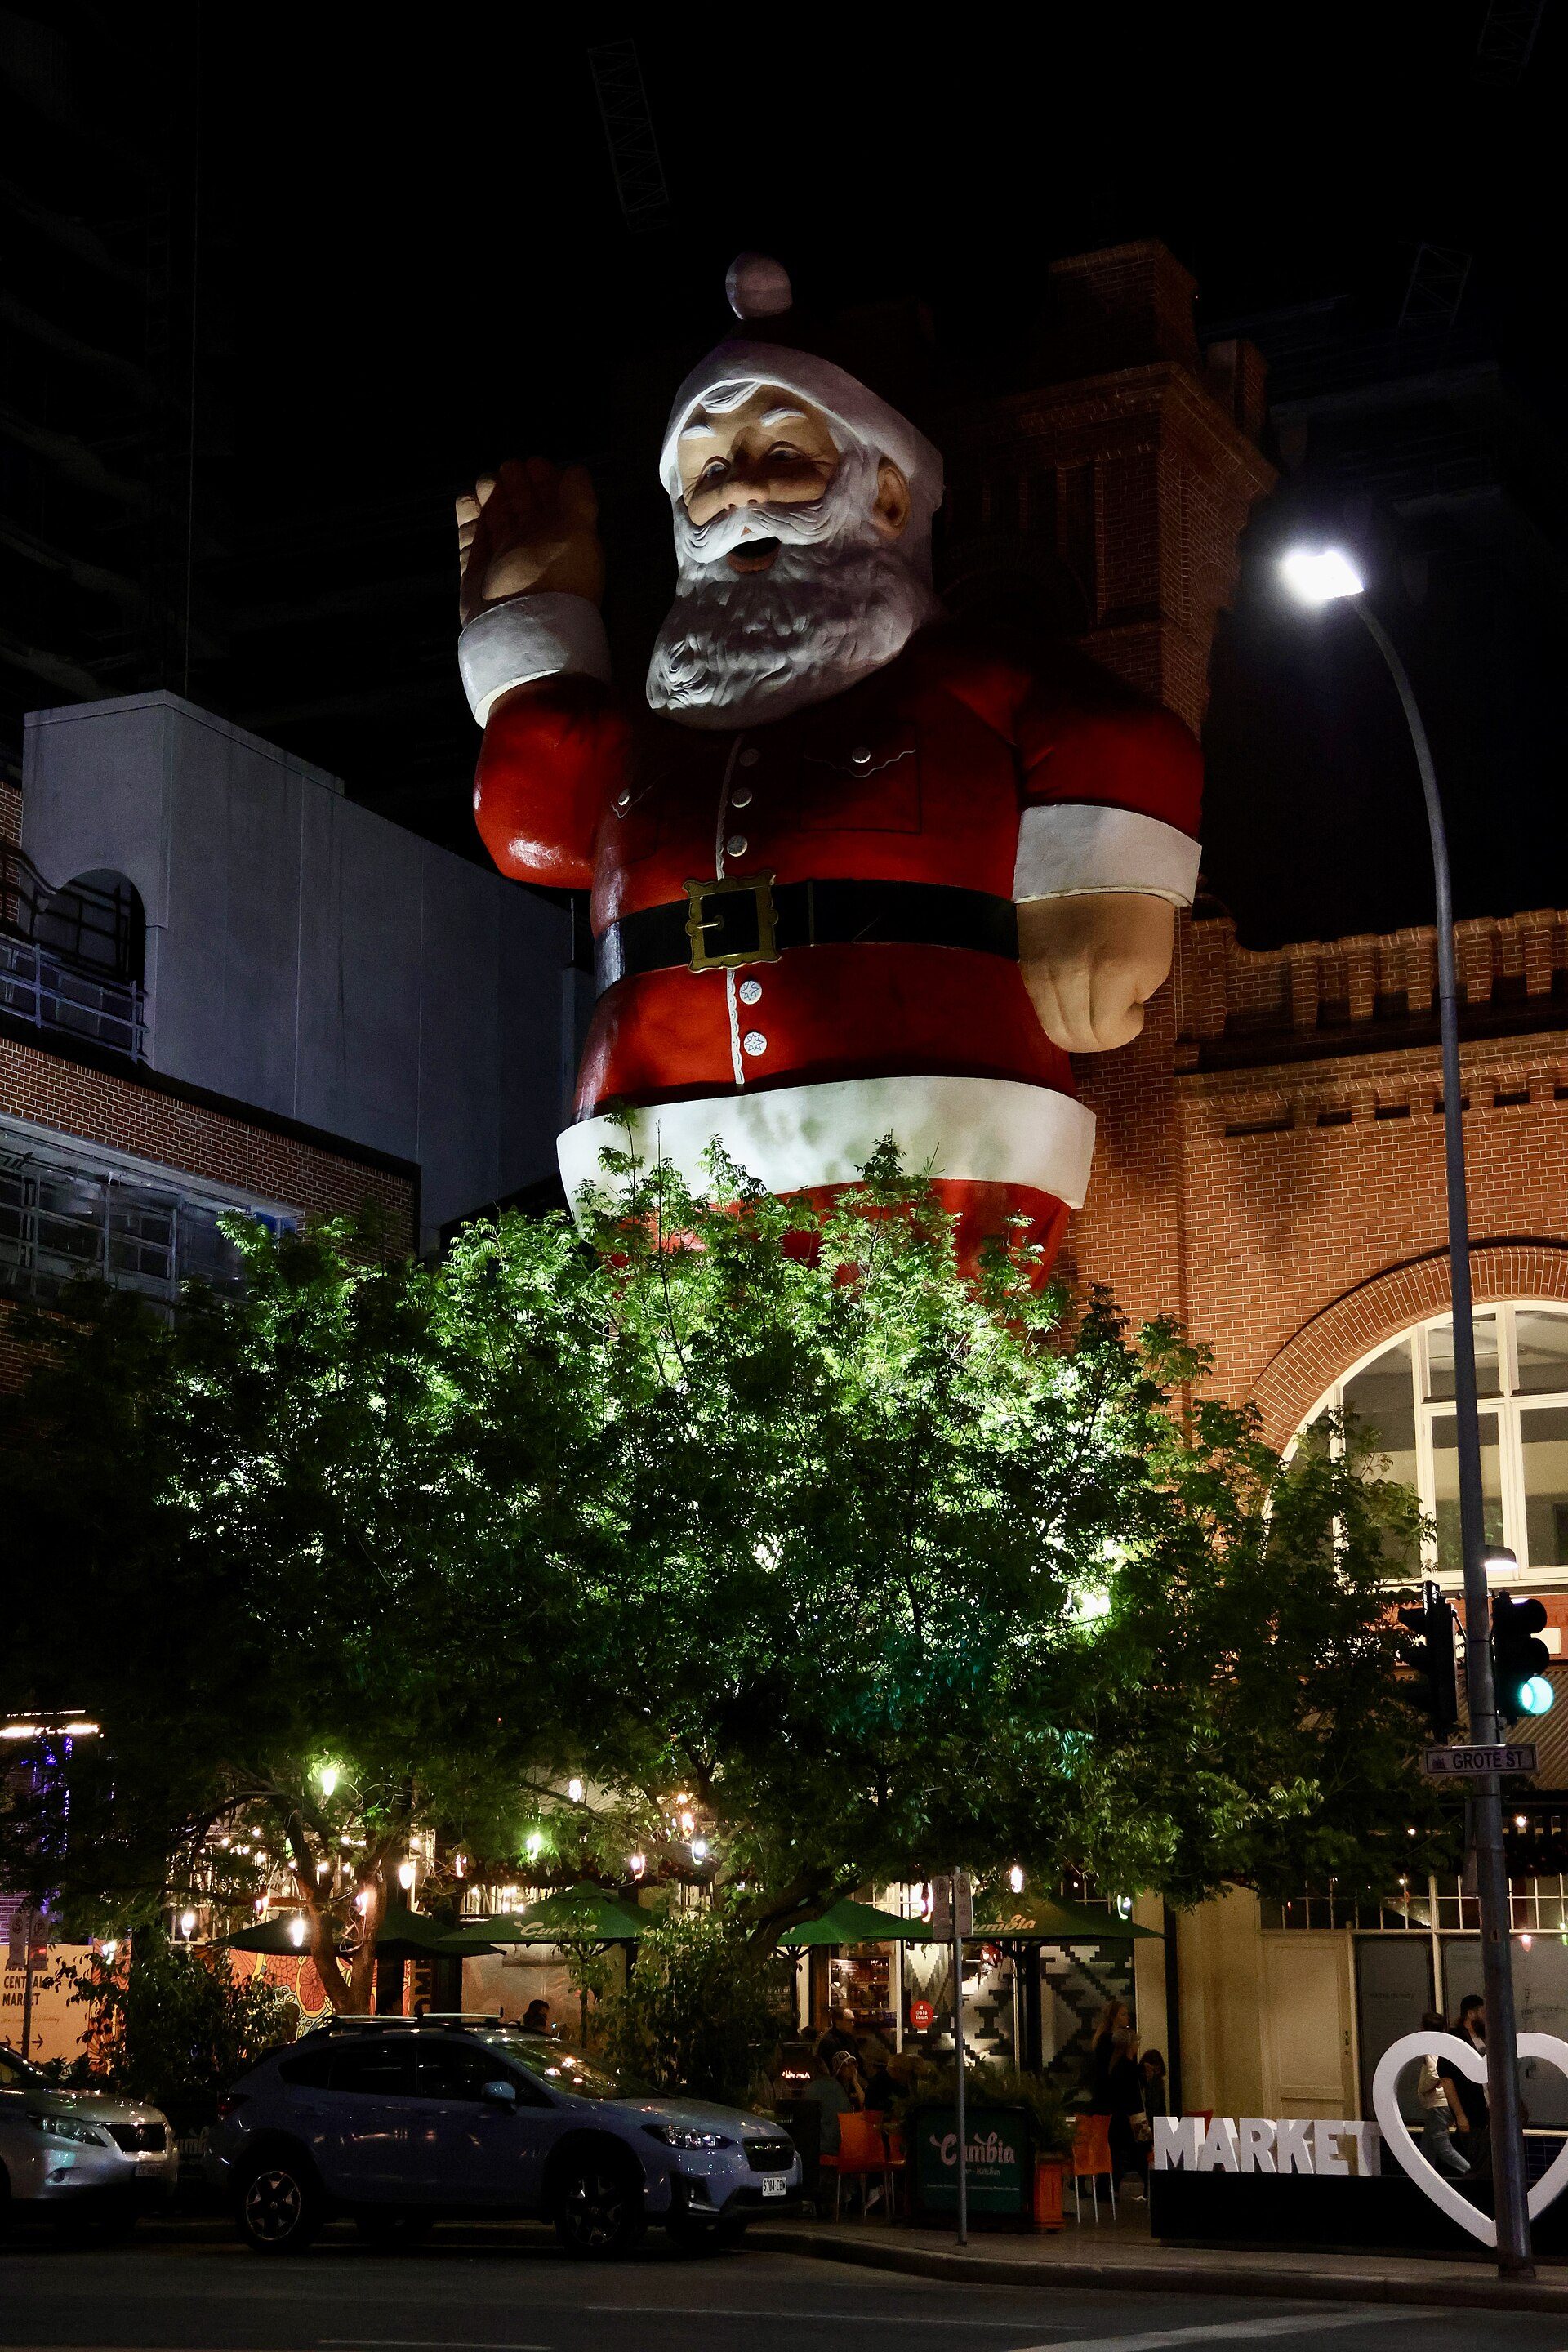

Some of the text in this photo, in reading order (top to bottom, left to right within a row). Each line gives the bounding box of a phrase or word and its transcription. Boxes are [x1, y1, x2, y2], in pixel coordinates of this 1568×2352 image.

[1452, 1750, 1523, 1770] GROTE ST
[972, 1913, 1036, 1931] umbia
[3, 1975, 45, 1989] CENTAL
[2, 1993, 41, 2007] MART
[1152, 2116, 1381, 2176] MARKET
